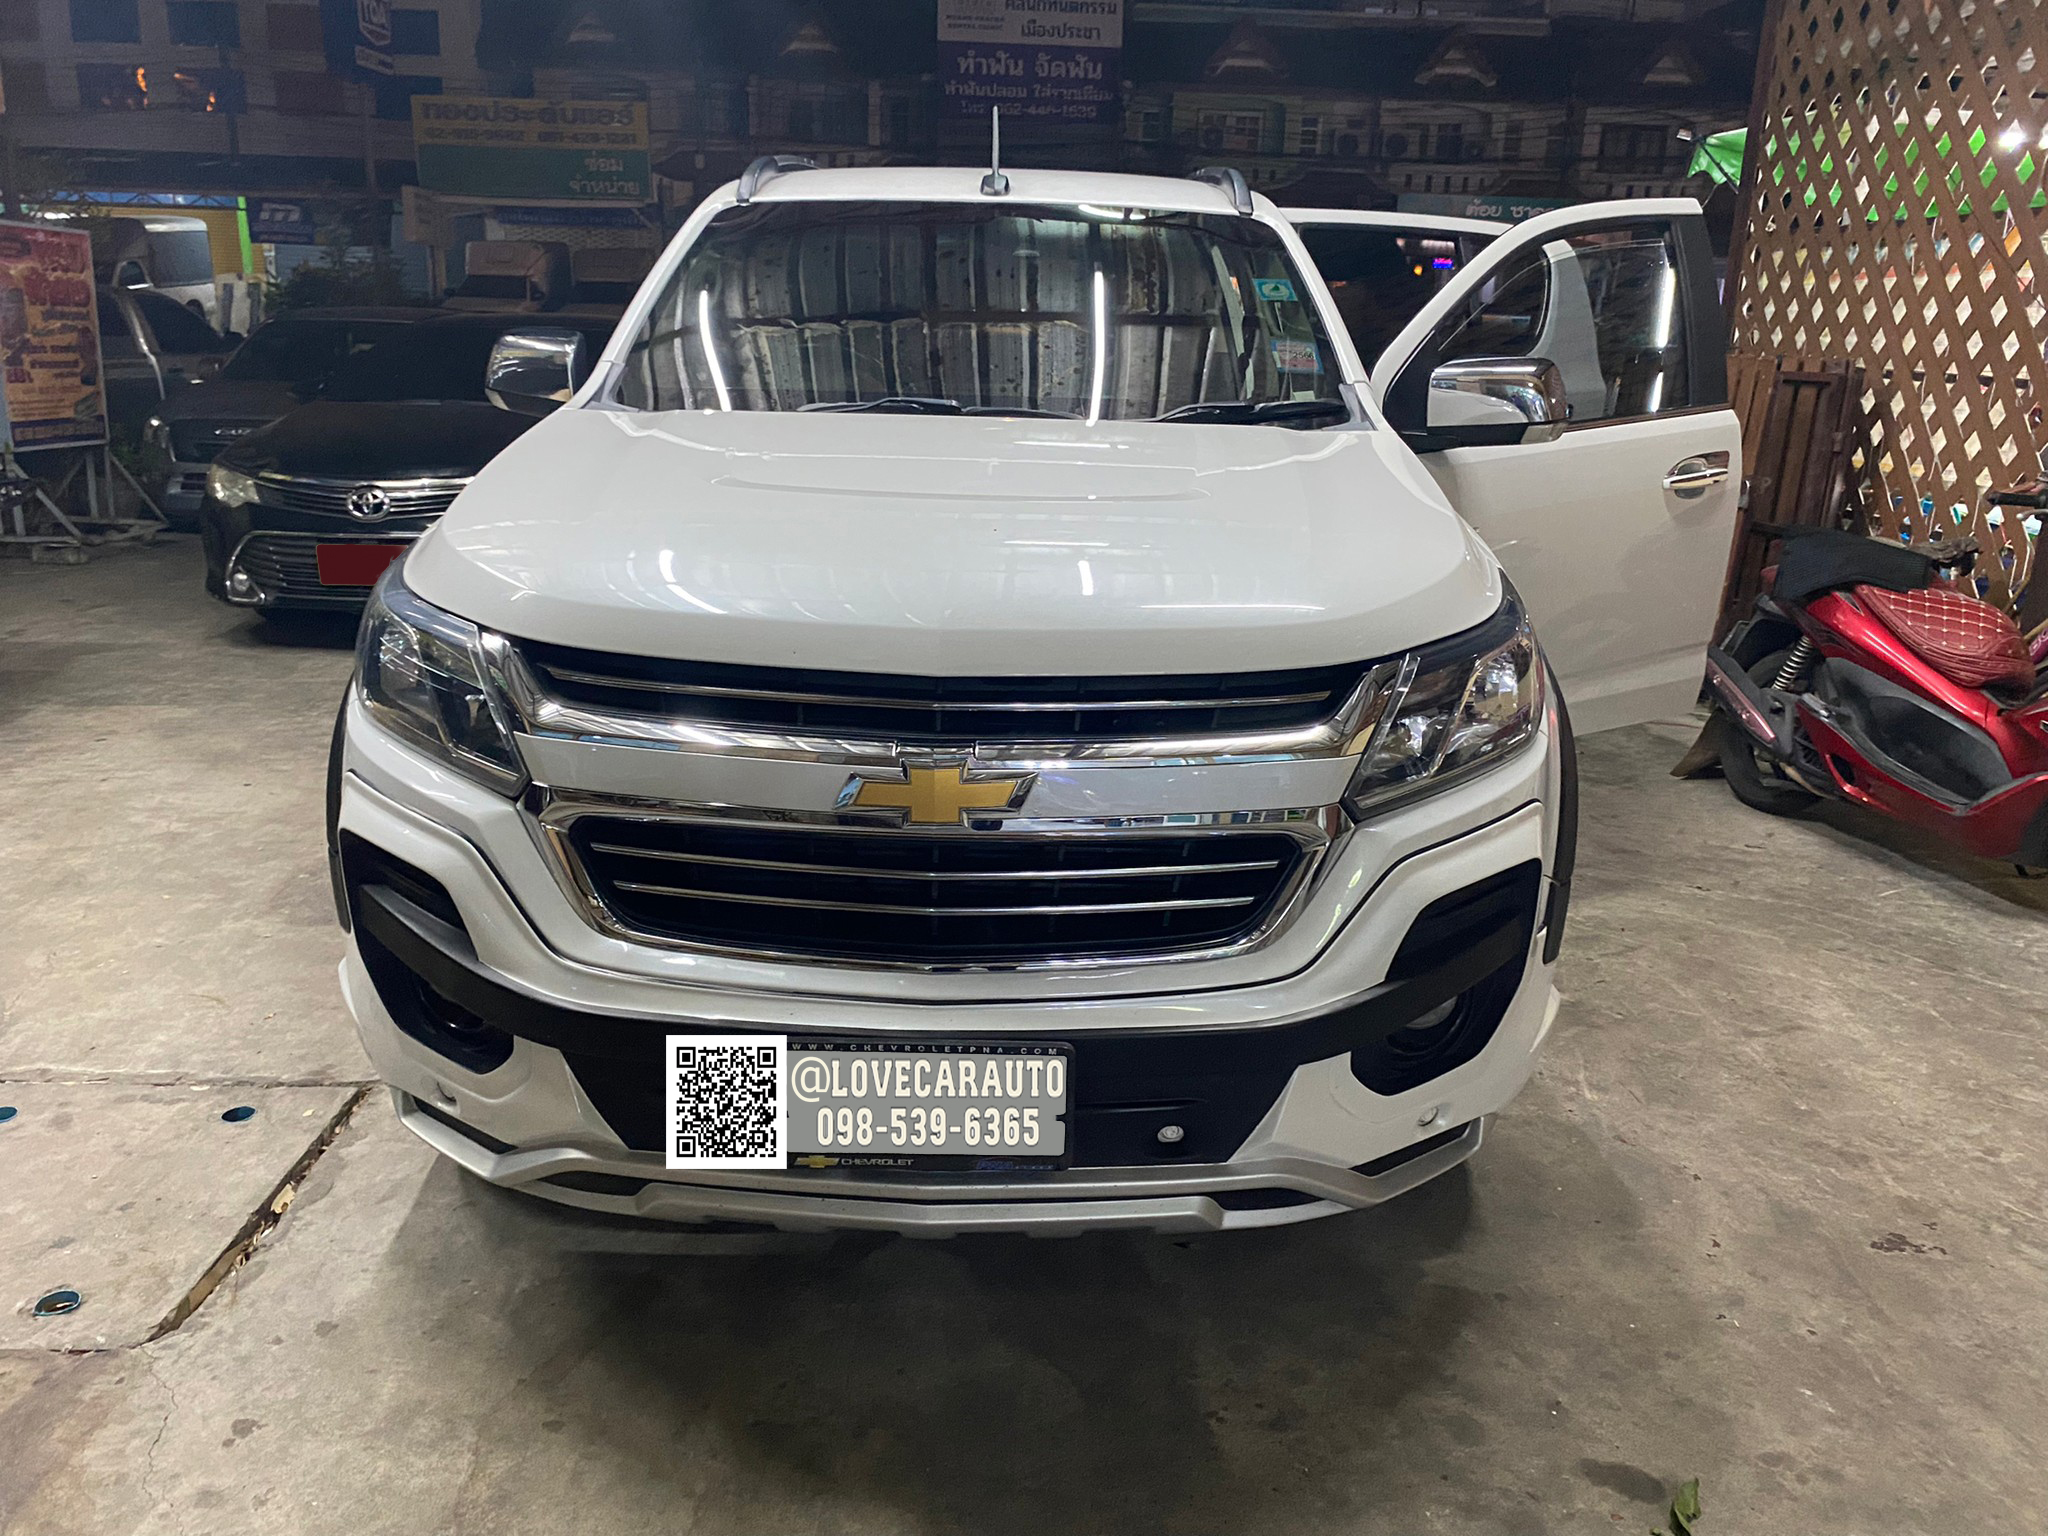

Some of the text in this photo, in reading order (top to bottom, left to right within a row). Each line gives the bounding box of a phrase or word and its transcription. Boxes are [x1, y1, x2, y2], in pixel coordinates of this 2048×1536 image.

[957, 50, 1103, 80] ทำฟัน จัดฟัน
[584, 150, 624, 171] ซ่อม
[841, 1157, 915, 1168] CHEVROLET
